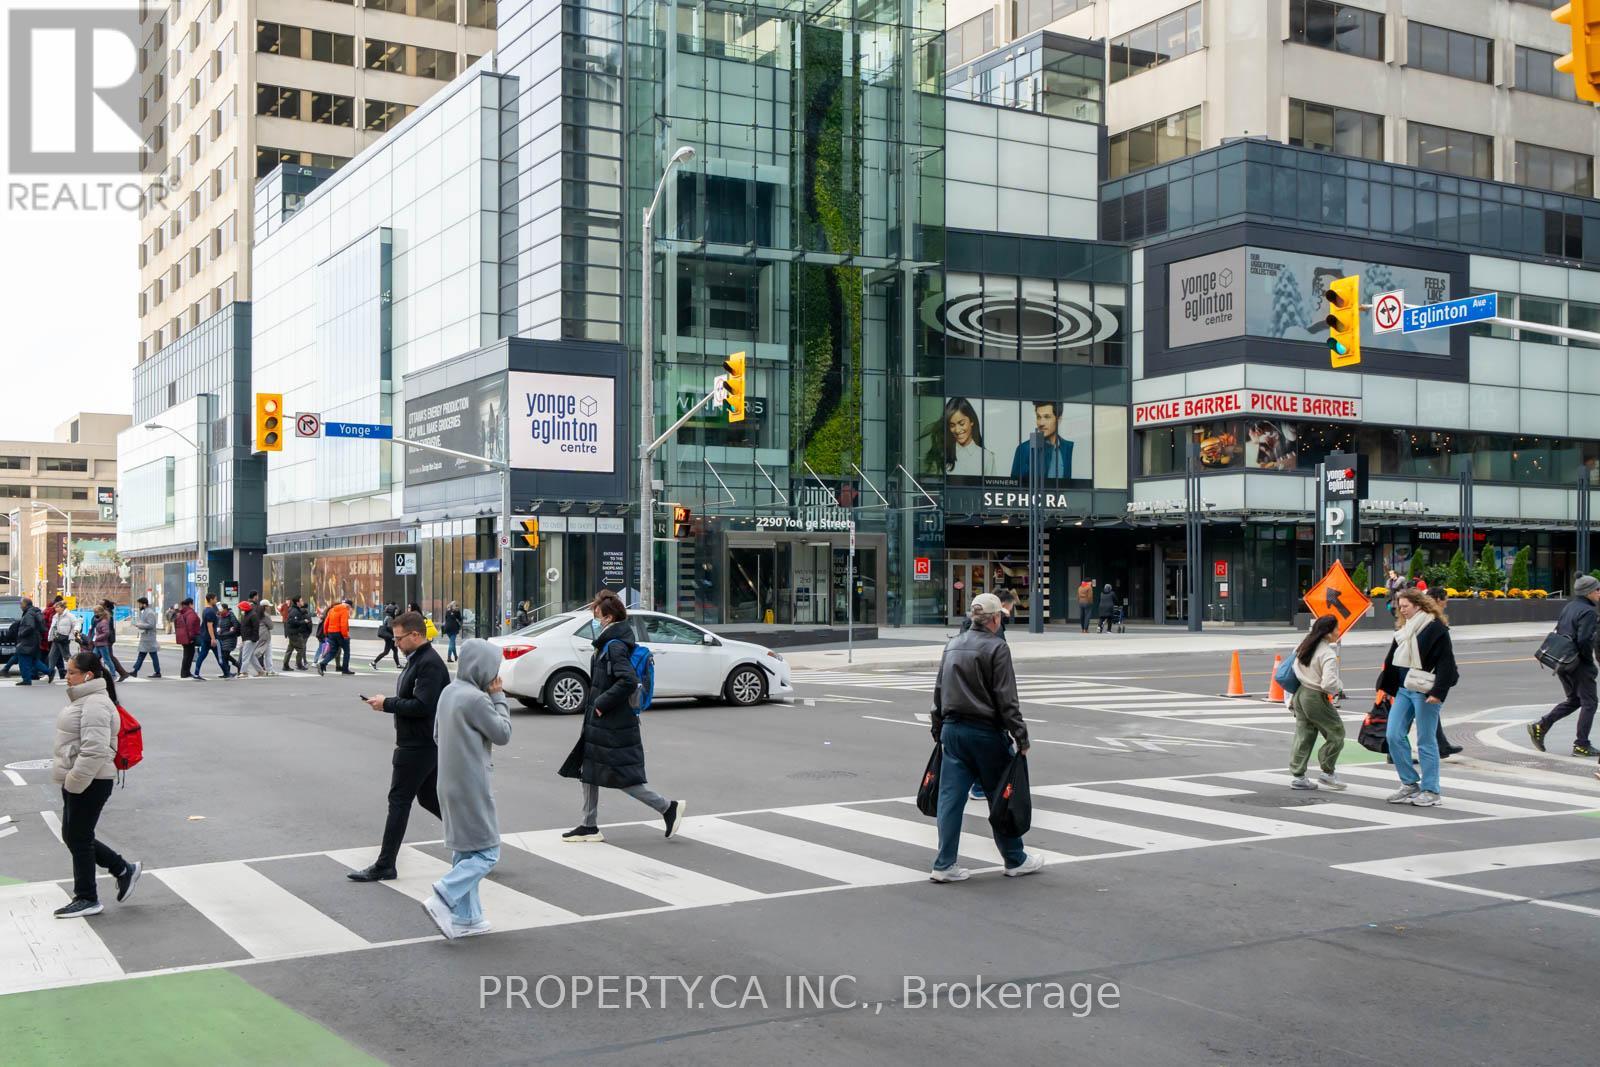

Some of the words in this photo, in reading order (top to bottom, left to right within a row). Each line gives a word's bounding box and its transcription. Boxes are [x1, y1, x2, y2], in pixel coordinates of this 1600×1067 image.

[1181, 271, 1217, 300] yonge
[1424, 277, 1446, 290] FEELS
[1427, 289, 1443, 300] LIKE
[1185, 292, 1233, 322] eglinton
[1411, 303, 1468, 329] Eglinton
[1472, 298, 1487, 308] Ave
[1205, 312, 1233, 325] centre
[526, 392, 576, 419] yonge
[677, 395, 765, 414] WIRS
[1136, 402, 1180, 423] PICKLE
[1184, 393, 1241, 417] BARREL
[1251, 393, 1298, 413] PICKLE
[339, 423, 371, 437] Yonge
[531, 415, 597, 445] eglinton
[560, 443, 597, 453] centre
[1326, 469, 1346, 482] yonge
[1328, 480, 1355, 493] eglinton
[984, 492, 1068, 508] SEPHORA
[103, 506, 113, 518] P
[756, 517, 782, 527] 2290
[820, 517, 853, 528] Street
[1326, 507, 1345, 536] P
[1418, 531, 1441, 539] aroma
[917, 562, 927, 572] R
[197, 574, 208, 582] 50
